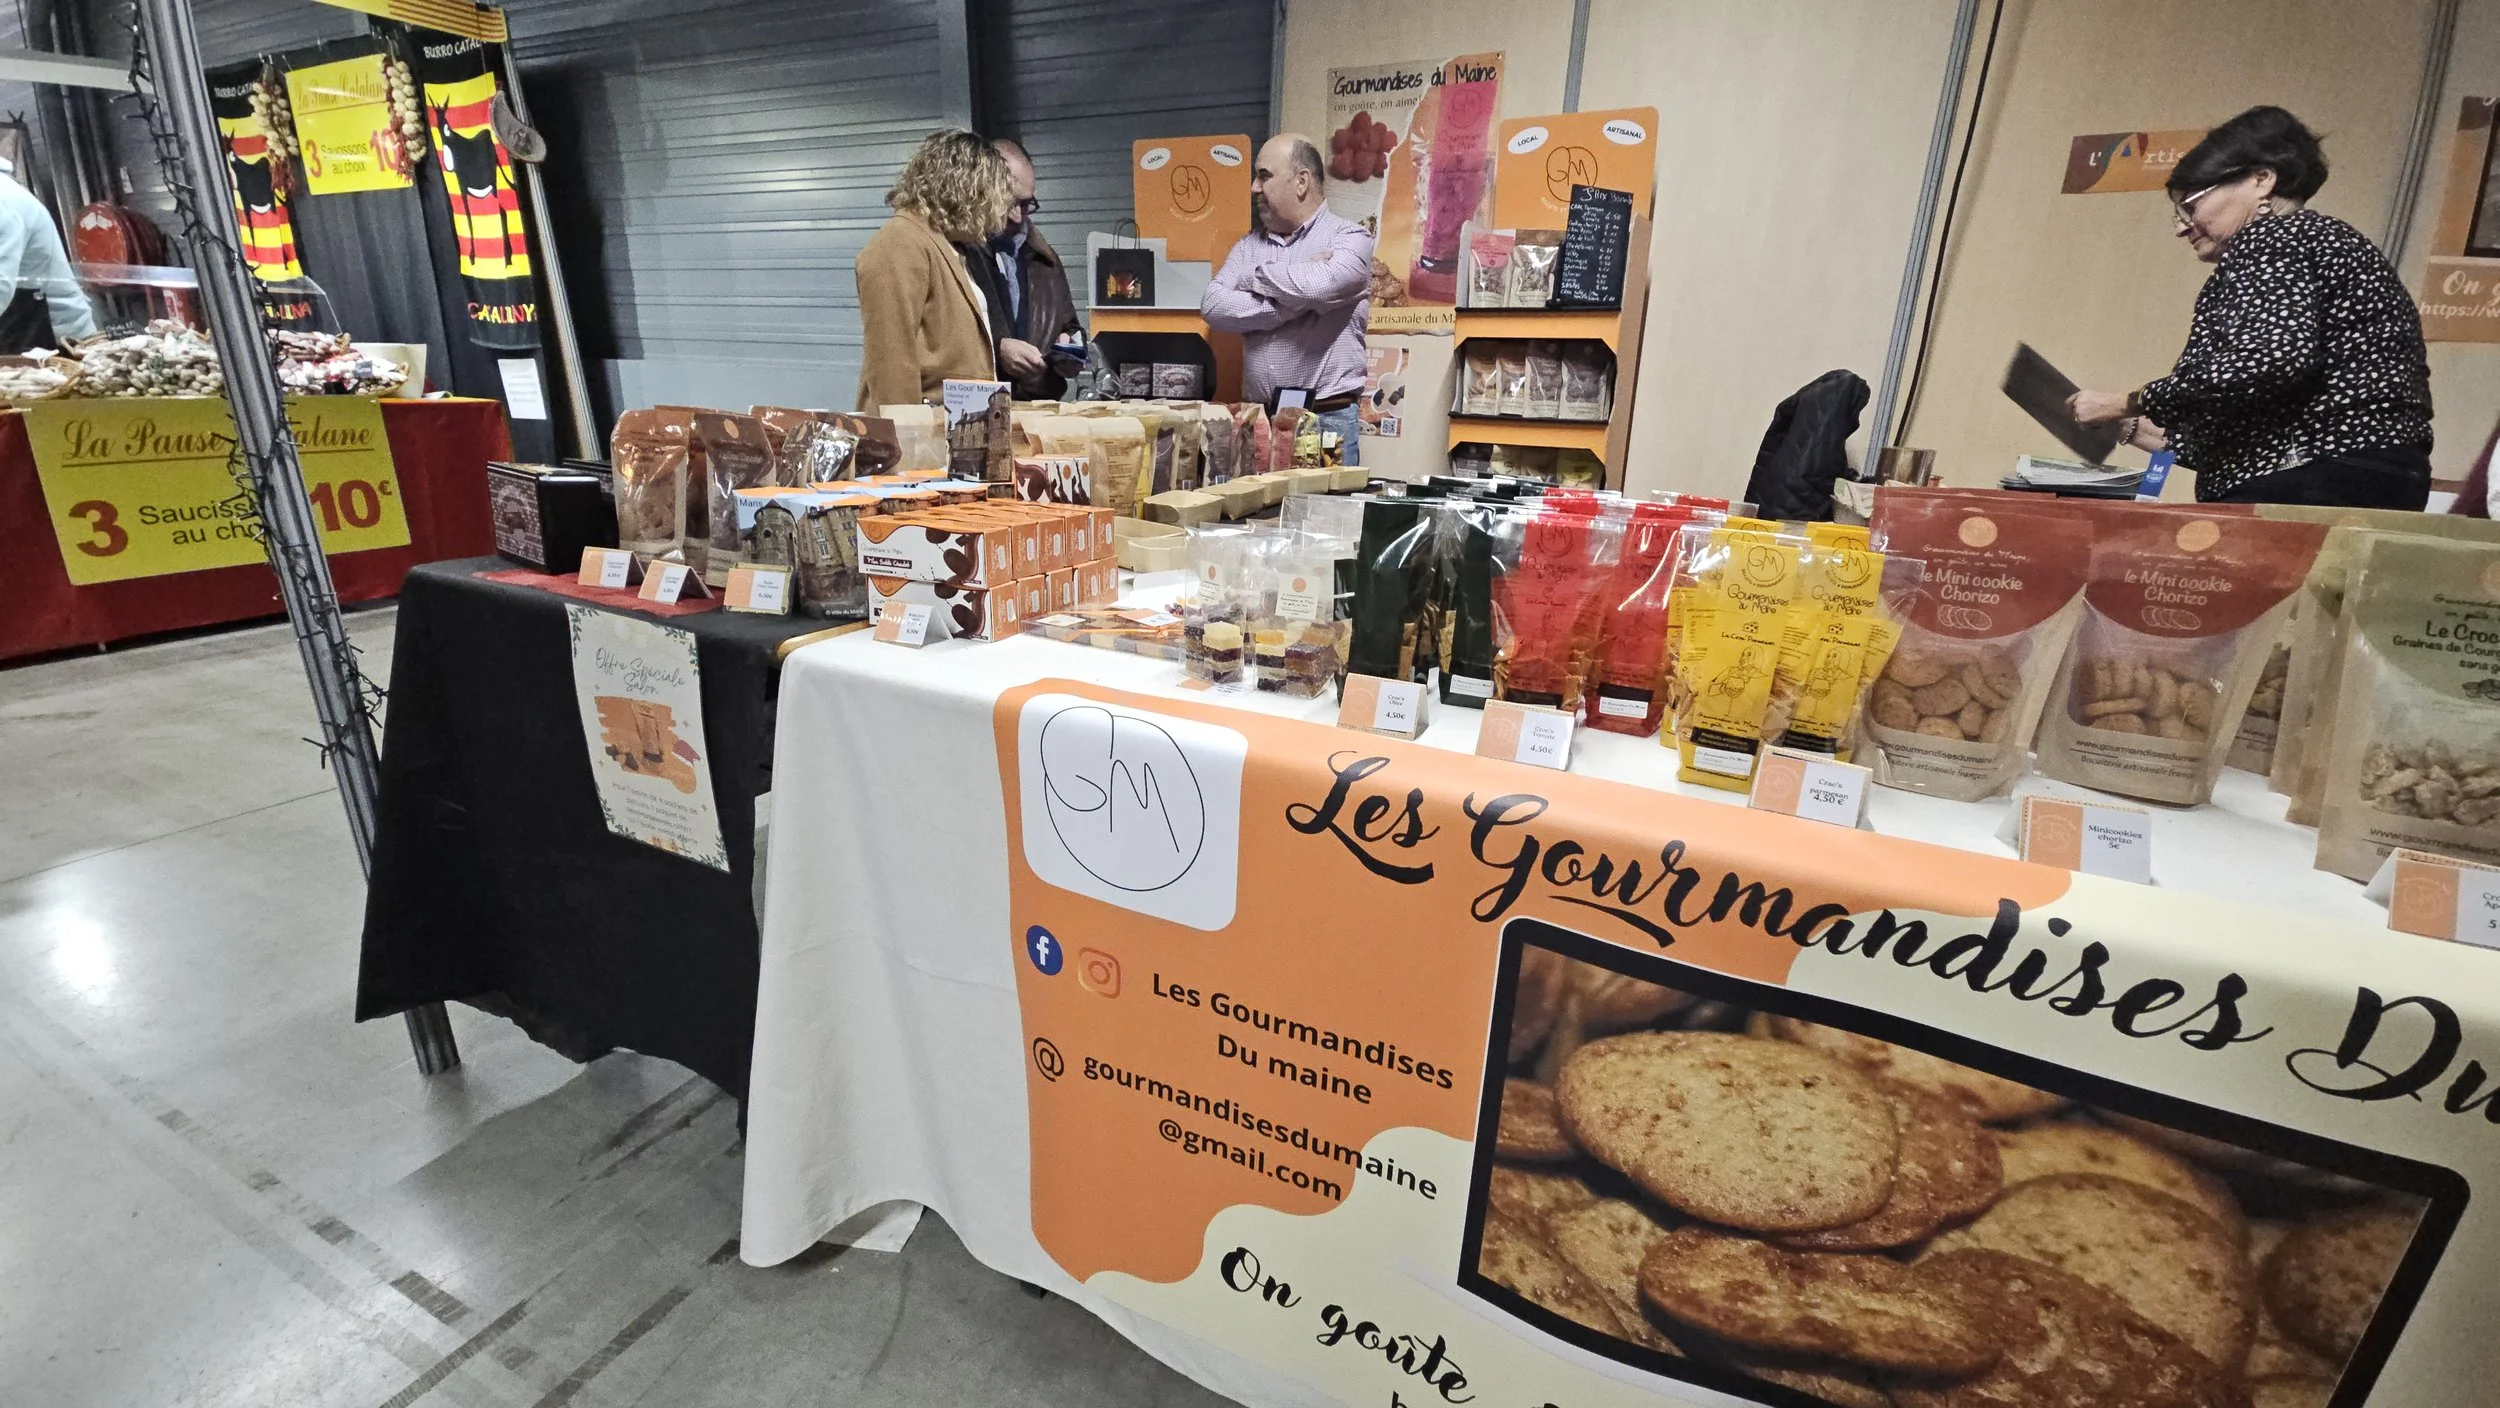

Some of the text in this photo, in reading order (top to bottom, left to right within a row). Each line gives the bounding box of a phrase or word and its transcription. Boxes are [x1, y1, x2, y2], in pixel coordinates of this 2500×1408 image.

[423, 38, 487, 58] BURRO CATAL
[1333, 63, 1497, 96] Gourmandises du Maine
[1334, 103, 1347, 112] on
[1381, 99, 1393, 108] on
[1517, 135, 1539, 147] LOCAL
[1606, 125, 1643, 139] ARTISANAL
[305, 139, 322, 177] 3
[1147, 154, 1164, 165] LOCAL
[1213, 149, 1241, 162] ARTISANAL
[331, 163, 343, 174] au
[344, 159, 367, 173] choix
[2442, 270, 2480, 296] On
[1374, 313, 1422, 324] artisanale
[1425, 313, 1438, 324] du
[64, 415, 373, 460] La Pause alane
[139, 499, 250, 526] Sauciss
[739, 499, 763, 508] Mans
[68, 500, 129, 557] 3
[172, 529, 206, 545] au
[216, 520, 264, 540] cho
[1920, 568, 2024, 591] le Mini cookie
[2124, 569, 2233, 592] le Mini cookie
[1940, 584, 2000, 605] Chorizo
[2145, 585, 2208, 605] Chorizo
[2425, 620, 2449, 638] Le
[2393, 635, 2443, 651] Graines
[2446, 642, 2461, 652] de
[2459, 660, 2488, 670] sans
[623, 672, 659, 695] Salon
[1809, 788, 1849, 800] parmesan
[2088, 824, 2143, 839] Minicookies
[2097, 834, 2132, 844] chorizo
[2109, 841, 2120, 849] 5€
[2487, 919, 2497, 929] 5
[1284, 750, 2500, 1125] Les Gourmandises Du
[1153, 972, 1455, 1090] Les Gourmandises
[1217, 1033, 1373, 1105] Du maine
[1083, 1053, 1438, 1201] gourmandisesdumaine
[1158, 1117, 1343, 1202] @gmail.com
[1220, 1246, 1476, 1404] On goûte
